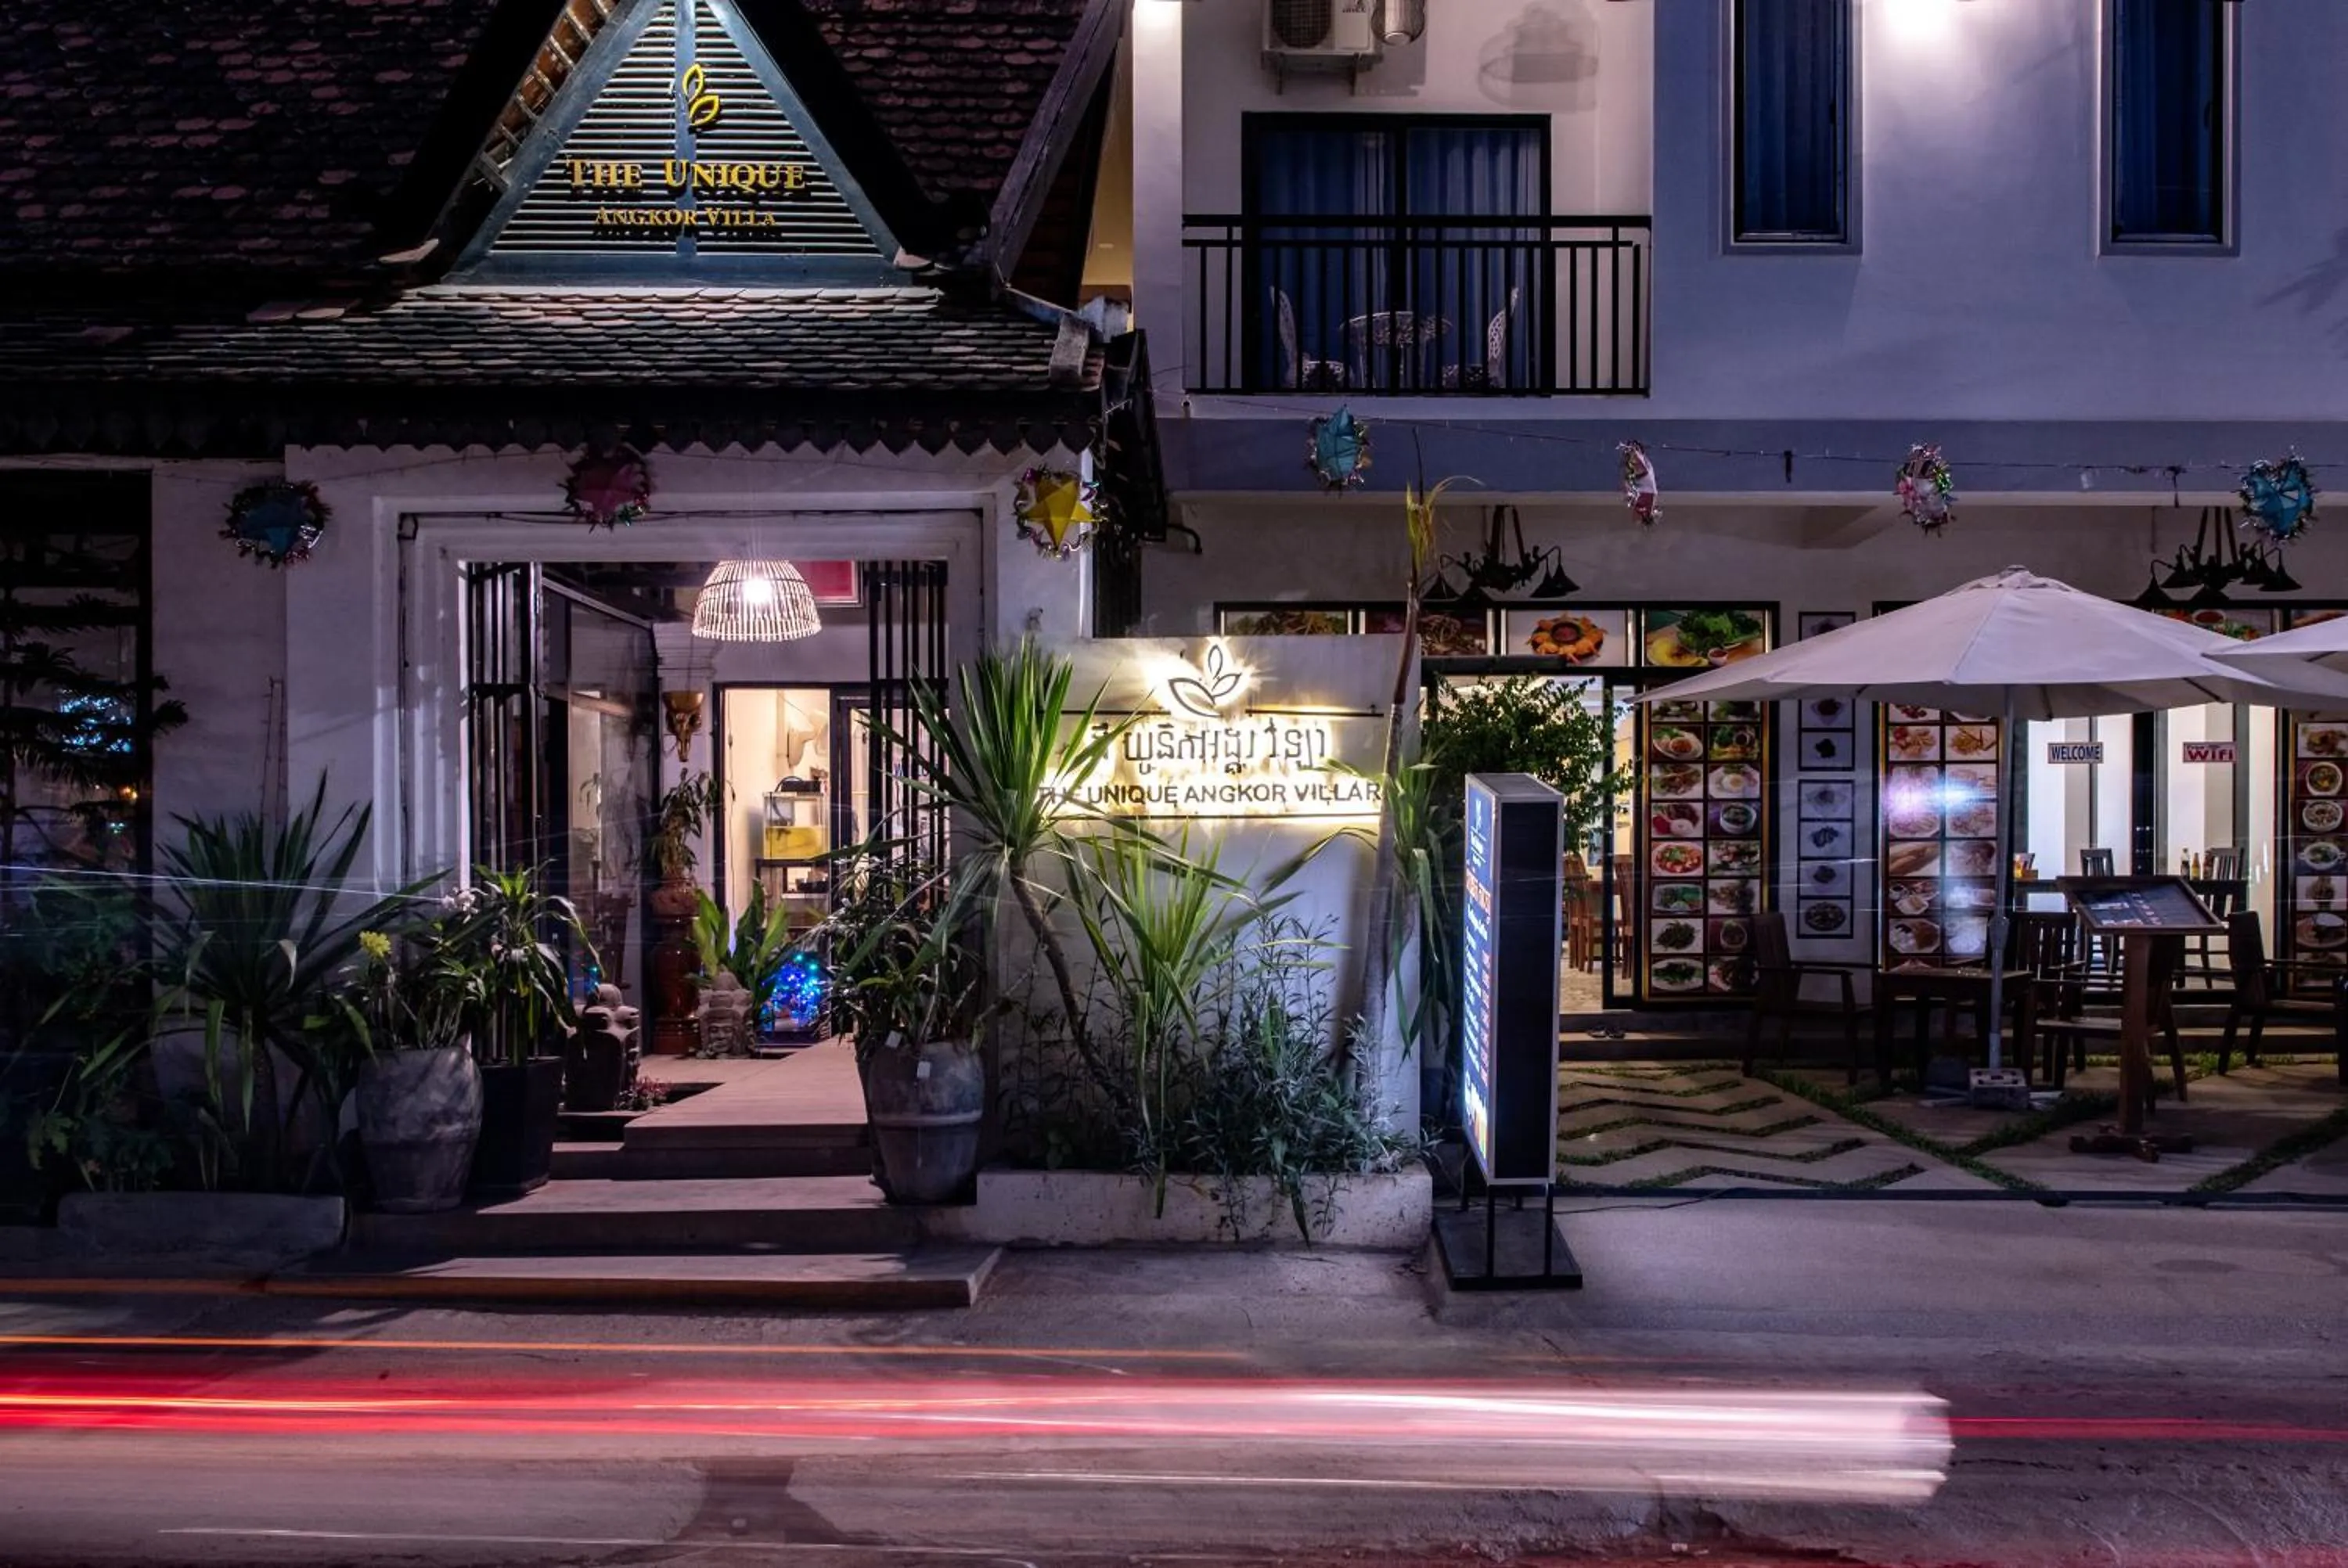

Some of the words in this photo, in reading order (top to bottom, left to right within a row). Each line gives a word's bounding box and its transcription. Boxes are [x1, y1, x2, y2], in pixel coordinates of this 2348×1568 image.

[568, 158, 643, 188] THE
[665, 159, 806, 192] UNIQUE
[596, 207, 697, 226] ANGKOR
[706, 207, 776, 226] VILLA
[2051, 746, 2100, 761] WELCOME
[1087, 784, 1179, 804] UNIQUE
[1183, 782, 1287, 803] ANGKOR
